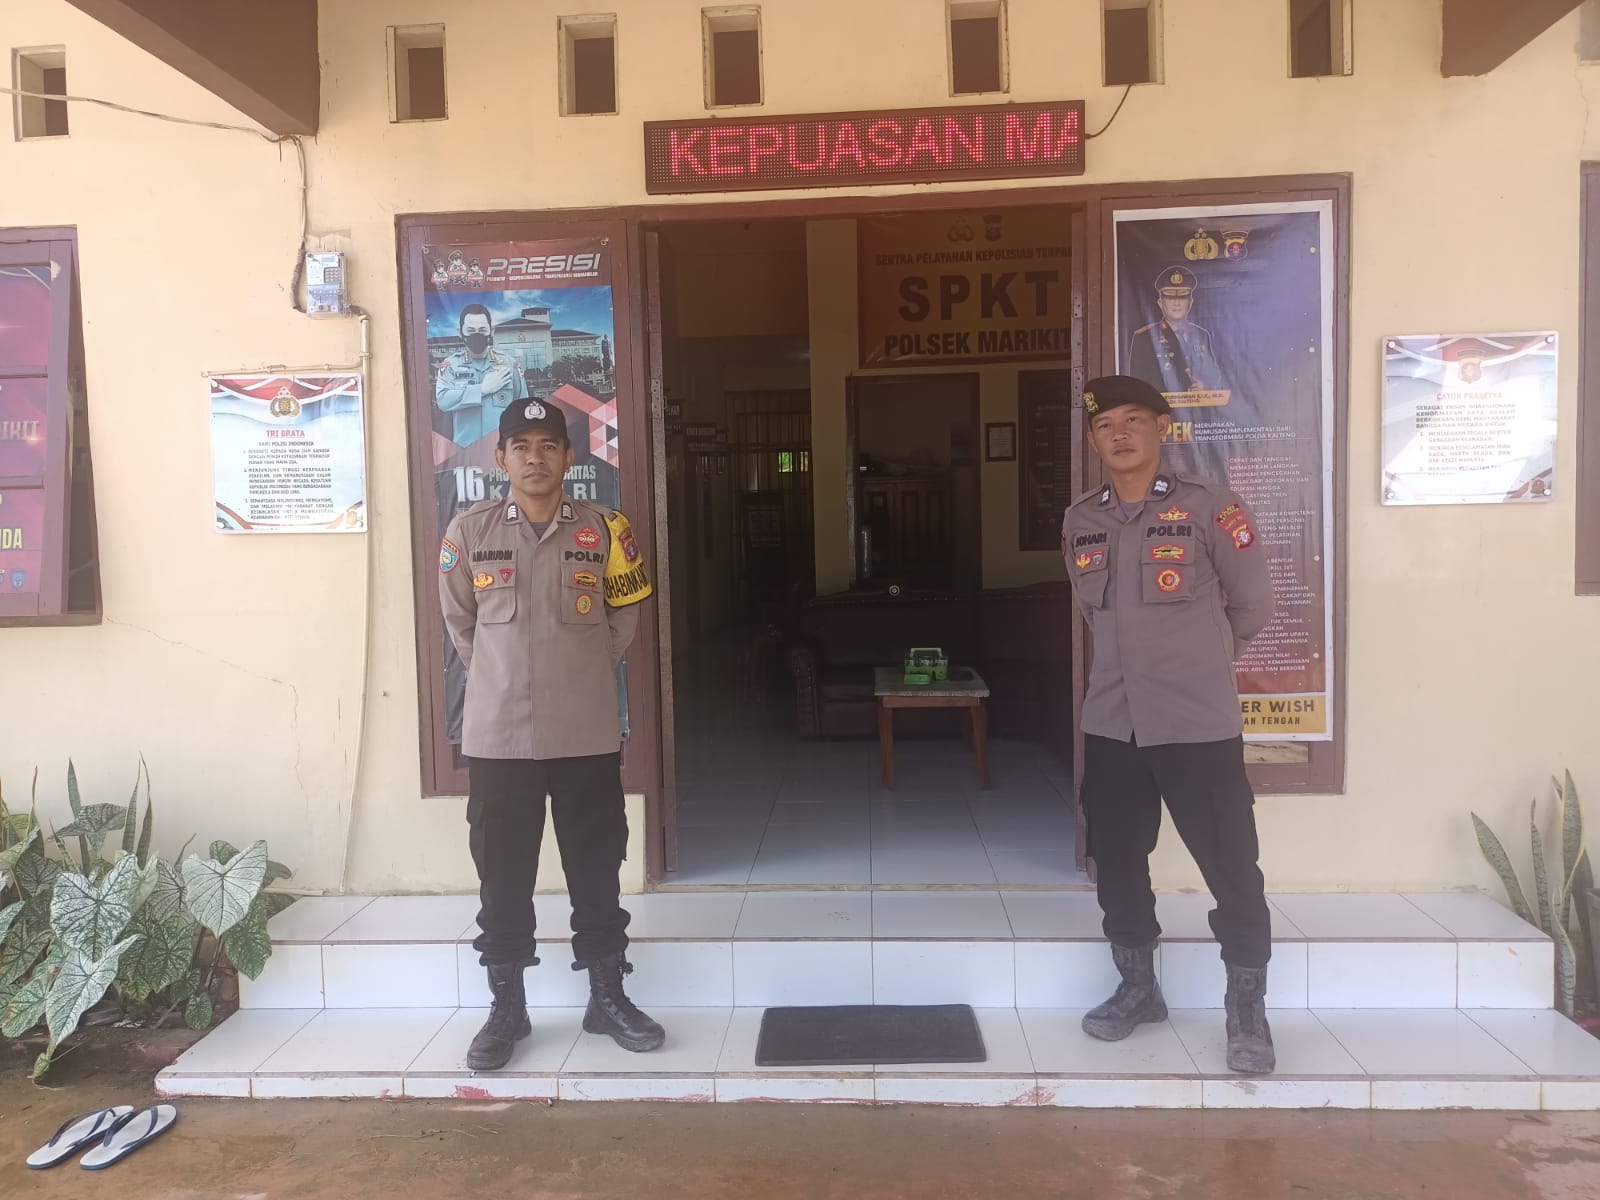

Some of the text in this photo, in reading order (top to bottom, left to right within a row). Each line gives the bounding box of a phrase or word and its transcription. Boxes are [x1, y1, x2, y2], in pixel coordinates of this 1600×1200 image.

[669, 115, 983, 176] KEPUASAN
[486, 253, 601, 275] PRESISI
[876, 253, 914, 265] SENTRA
[915, 249, 973, 264] PELAYANAN
[975, 247, 1034, 262] KEPOLISIAN
[898, 270, 1059, 322] SPKT
[885, 332, 971, 356] POLSEK
[266, 429, 305, 438] TRI BRATA
[1228, 426, 1274, 434] IMPLEMENTASI
[453, 466, 485, 502] 16
[0, 528, 22, 549] DA
[1147, 525, 1192, 538] POLRI
[565, 551, 605, 565] POLRI
[1269, 699, 1314, 713] WISH
[1261, 716, 1301, 725] TENGAH
